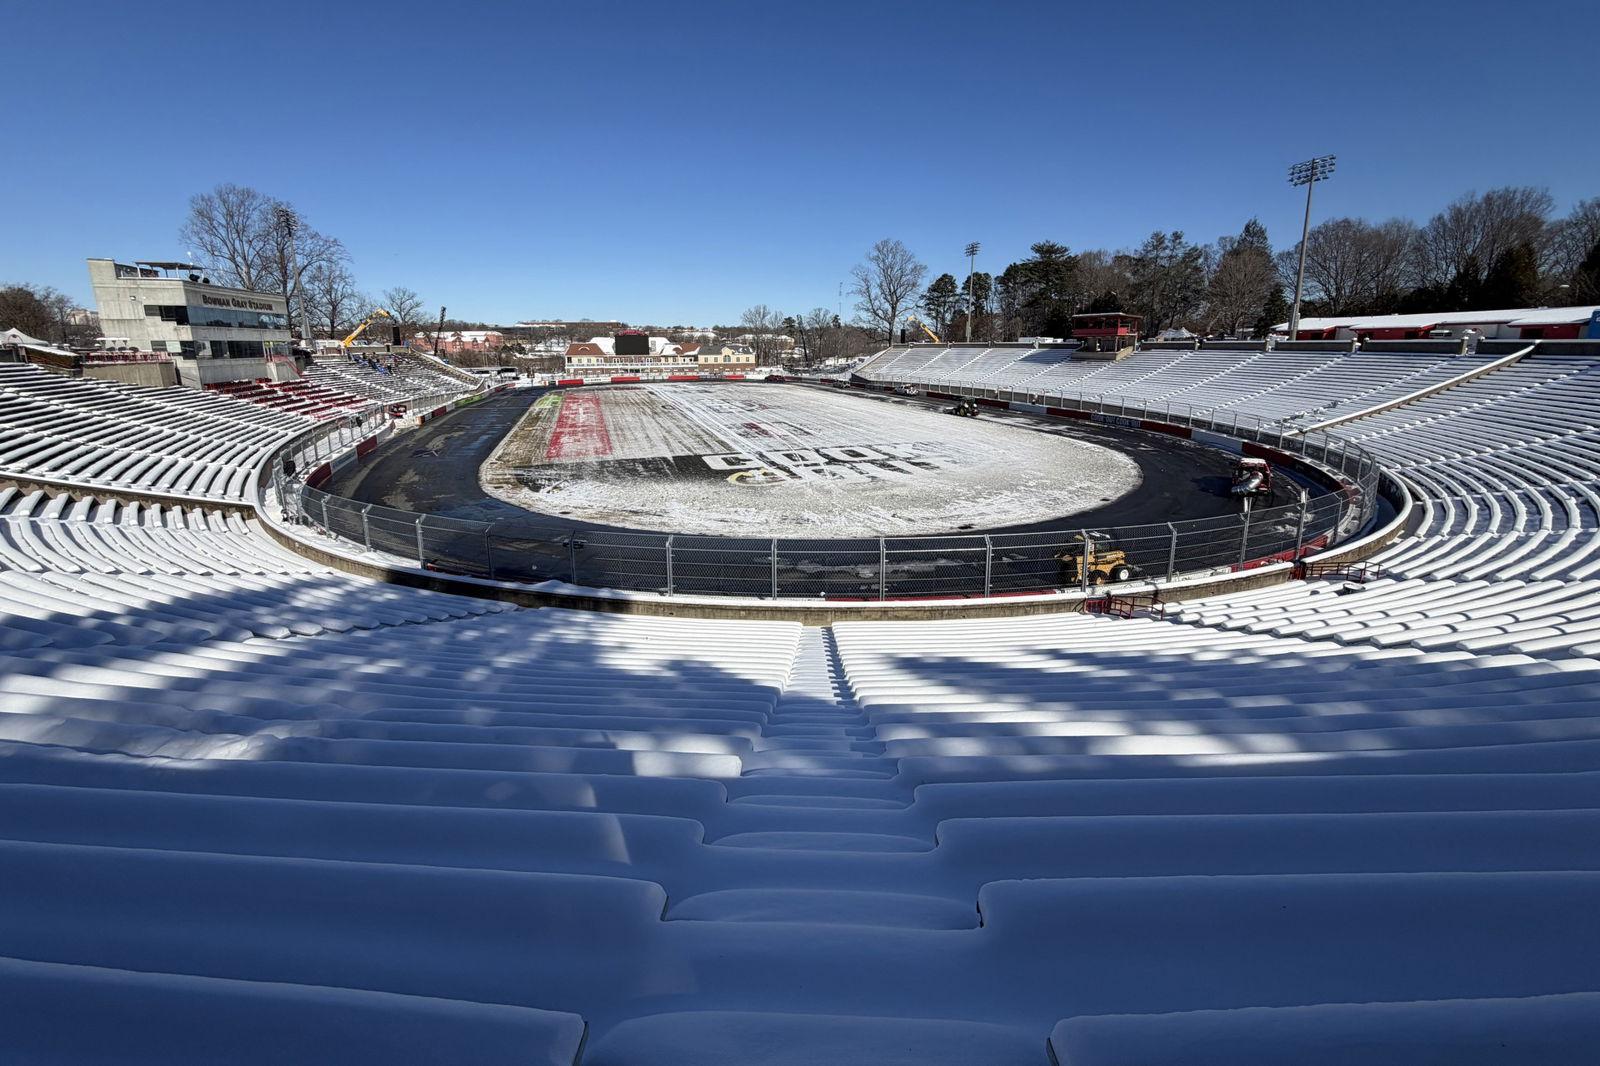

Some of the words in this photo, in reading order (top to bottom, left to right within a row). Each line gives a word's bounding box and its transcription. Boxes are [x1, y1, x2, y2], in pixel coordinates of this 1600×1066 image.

[202, 294, 231, 307] BOWMAN
[231, 298, 248, 309] GRAY
[248, 300, 273, 311] STADIUM
